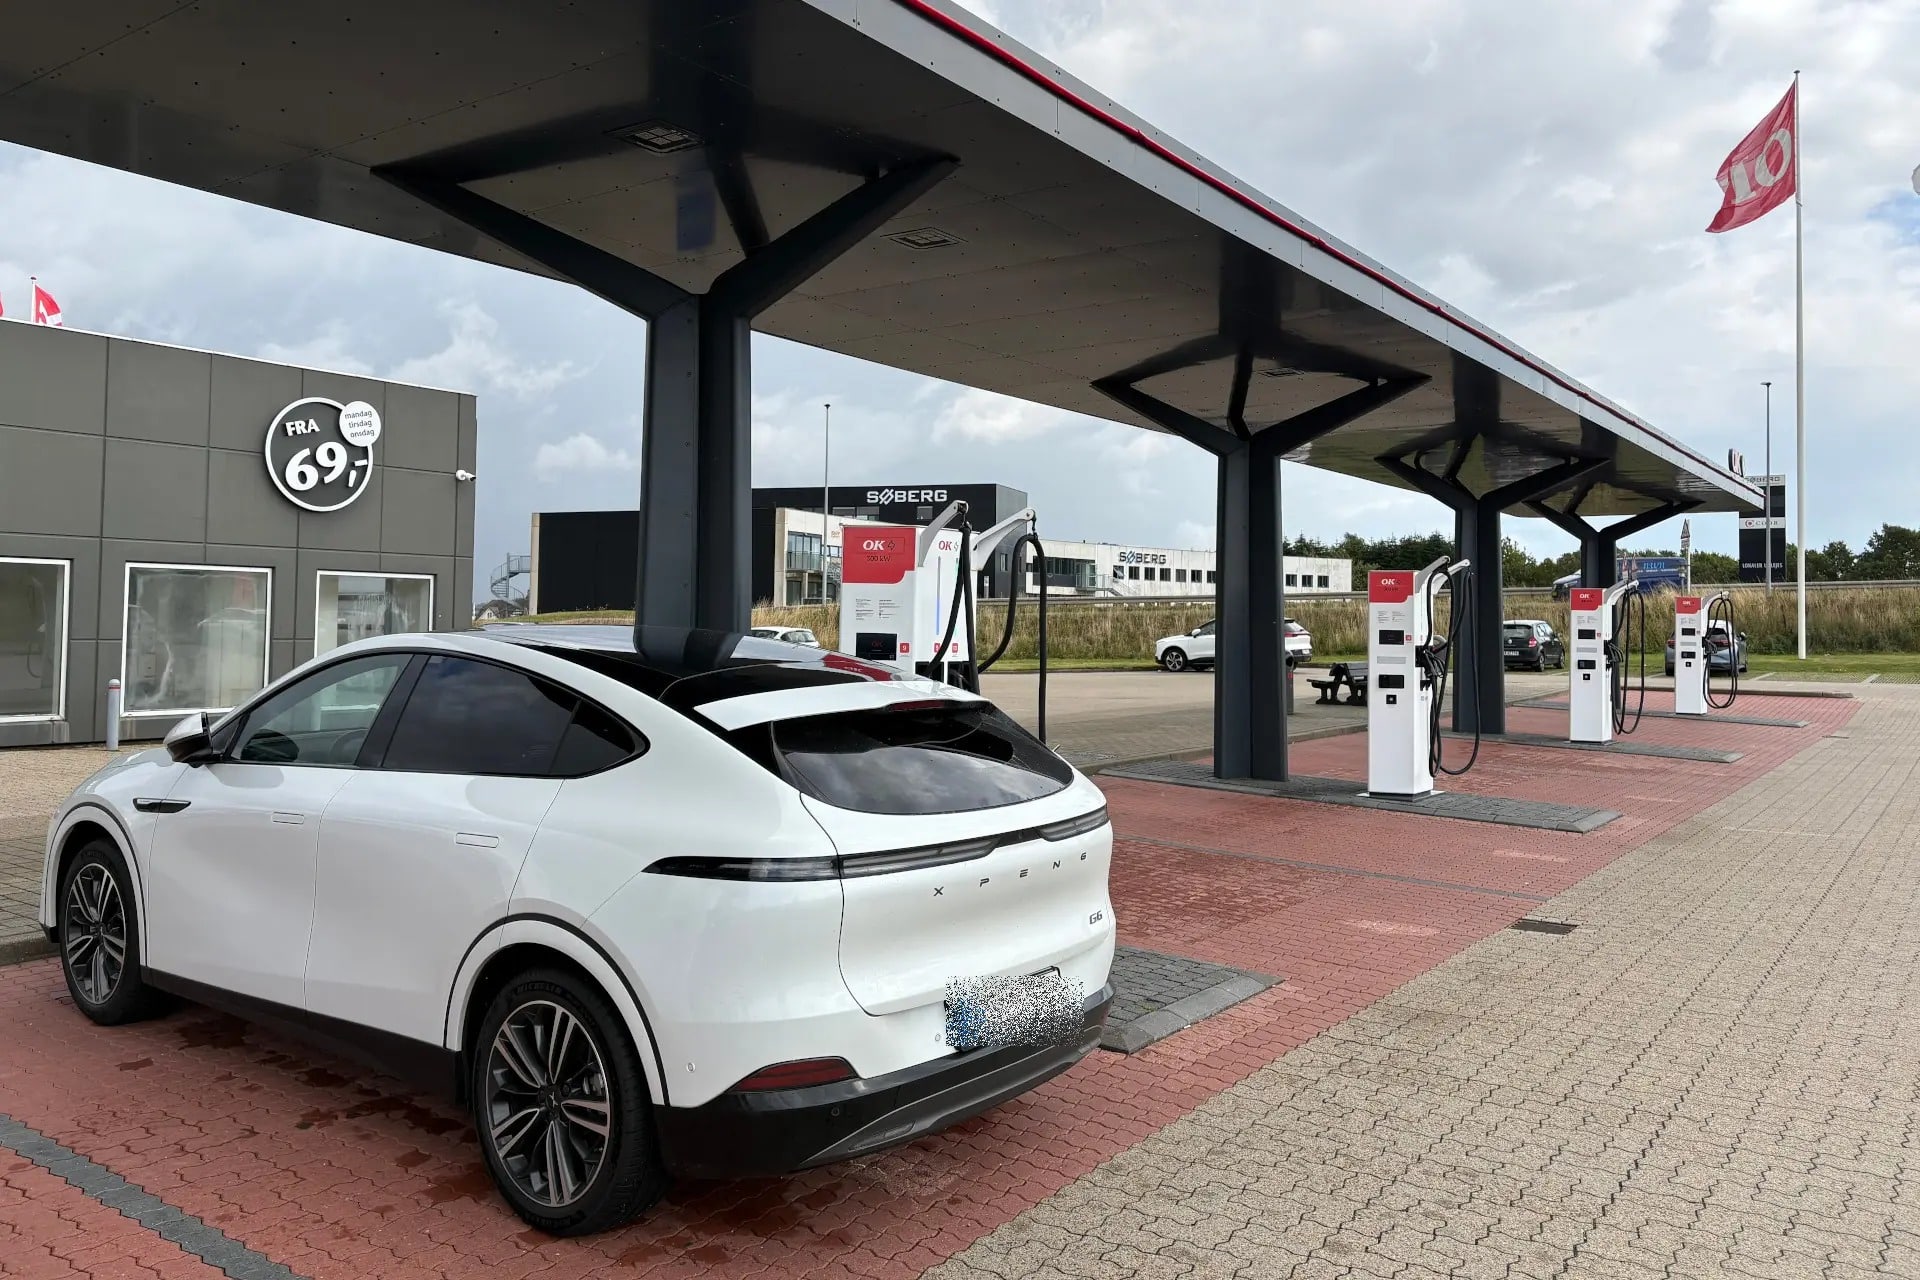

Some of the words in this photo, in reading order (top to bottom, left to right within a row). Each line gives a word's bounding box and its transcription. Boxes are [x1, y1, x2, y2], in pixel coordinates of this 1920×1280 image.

[344, 410, 373, 419] mandag
[285, 418, 320, 436] FRA
[348, 420, 372, 429] tirsdag
[350, 429, 375, 438] onsdag
[866, 488, 948, 505] SØBERG
[862, 540, 886, 551] OK
[938, 540, 953, 551] OK
[1089, 910, 1103, 925] G6
